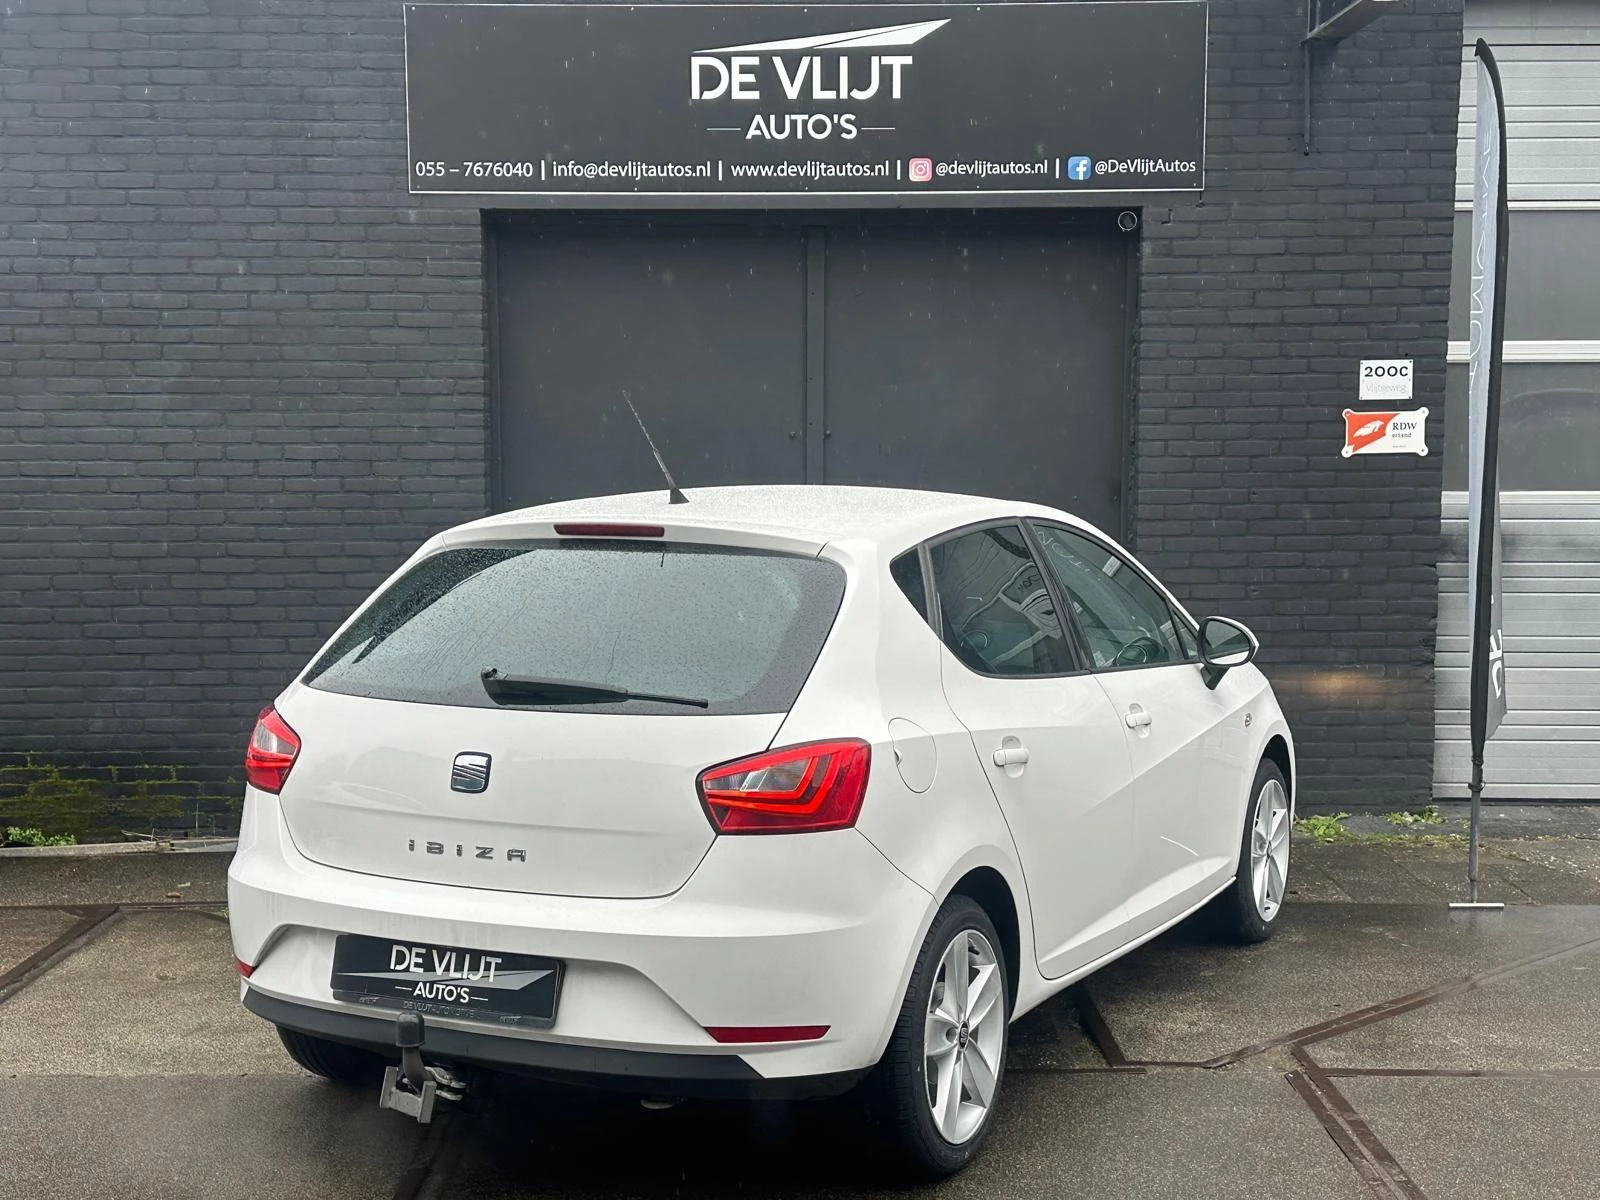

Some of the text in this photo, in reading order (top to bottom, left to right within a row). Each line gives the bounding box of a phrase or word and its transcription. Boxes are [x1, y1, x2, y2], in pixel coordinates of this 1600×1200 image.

[691, 55, 912, 101] DE VLIJT
[746, 113, 859, 141] AUTO'S
[415, 161, 446, 178] 055
[463, 161, 534, 179] 7676040
[552, 160, 711, 181] info@devlijtautos.nl
[731, 160, 889, 181] www.devlijtautos.nl
[935, 160, 1048, 180] @devlijtautos.nl
[1094, 159, 1197, 178] @DeVlijtAutos
[1392, 421, 1417, 431] RDW
[408, 839, 527, 863] IBIZA
[390, 944, 502, 983] DE VLIJT
[413, 982, 469, 1003] AUTO'S
